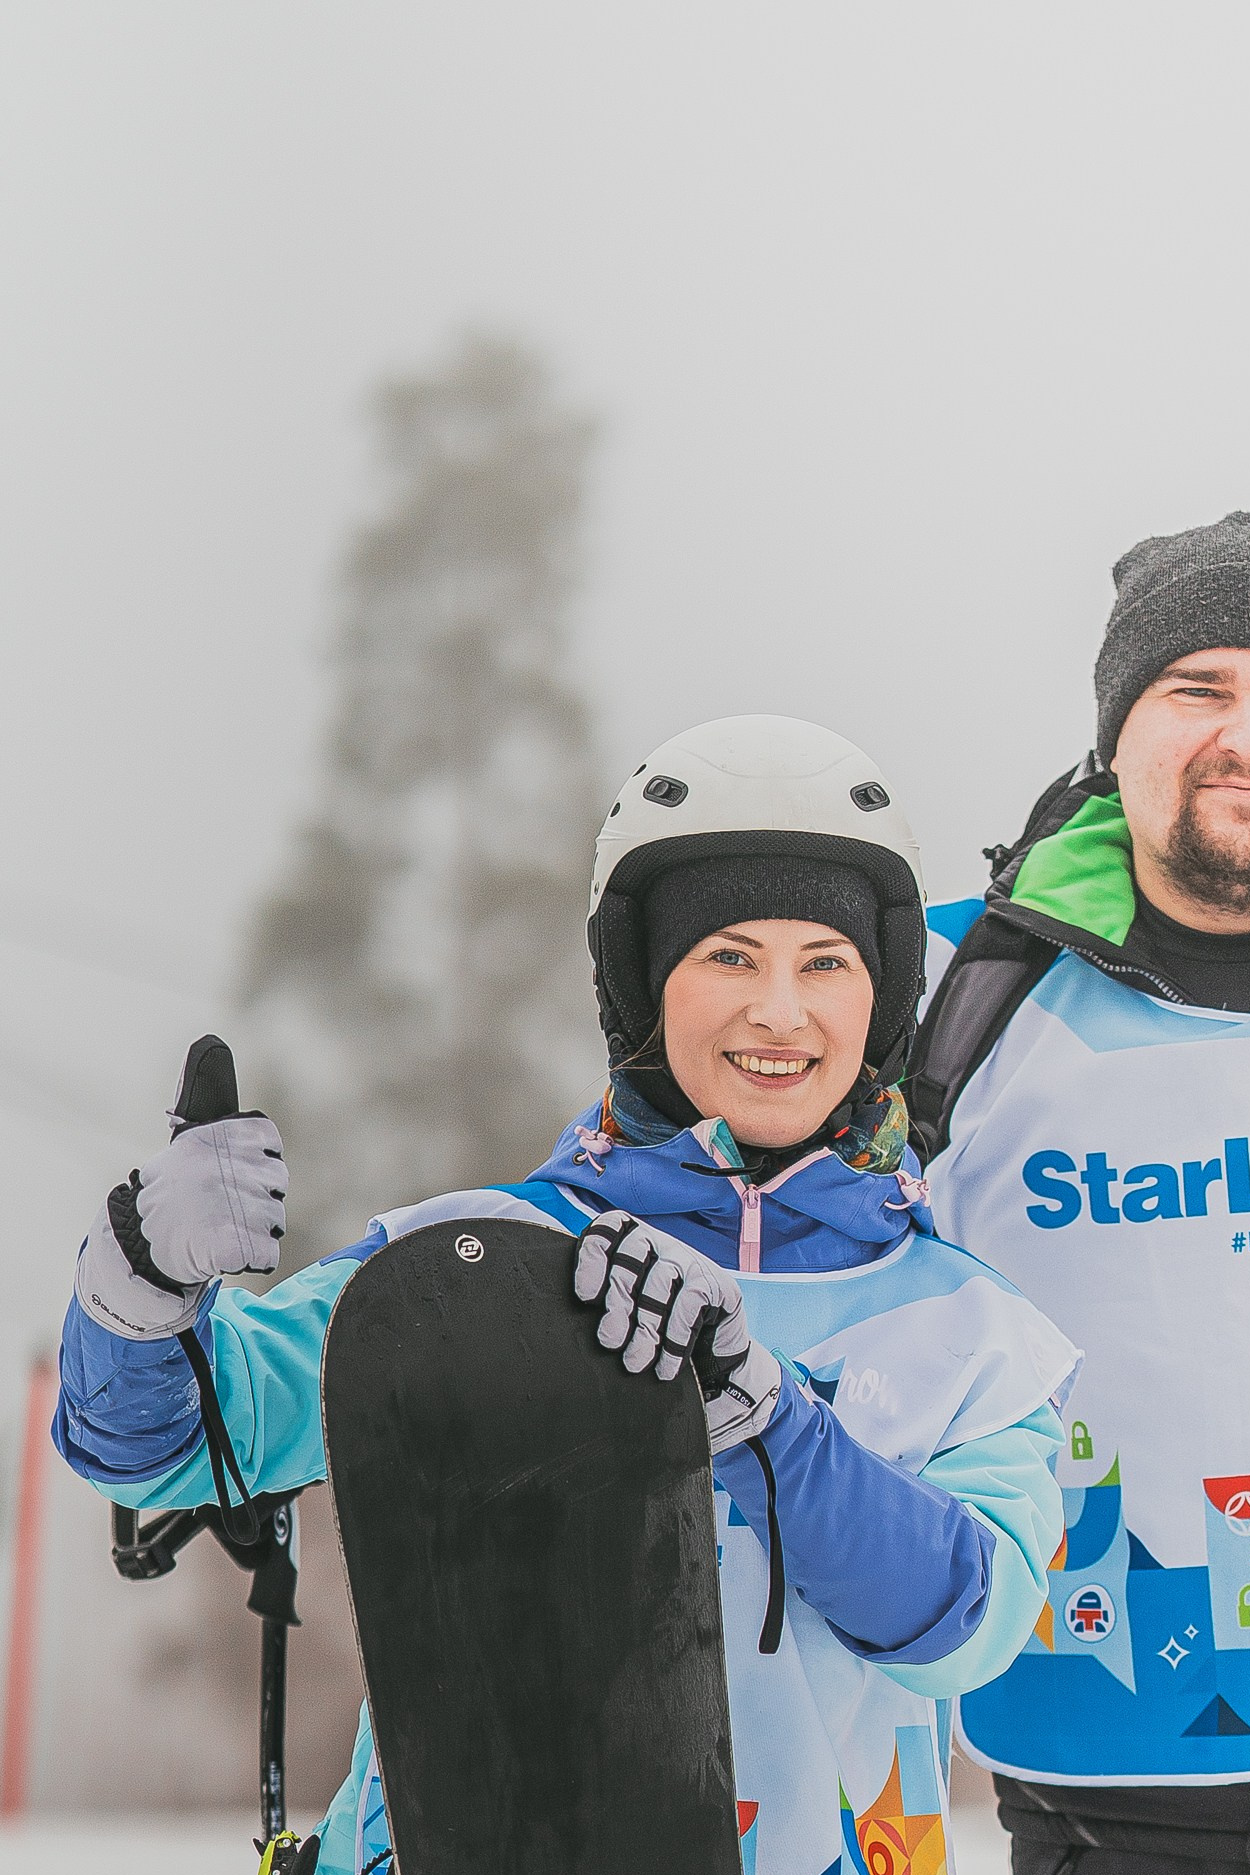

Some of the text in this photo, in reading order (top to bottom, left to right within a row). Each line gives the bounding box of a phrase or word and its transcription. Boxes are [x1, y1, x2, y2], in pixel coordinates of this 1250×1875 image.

[100, 1303, 146, 1333] GLISSADE
[725, 1386, 751, 1407] ISO LOFT
